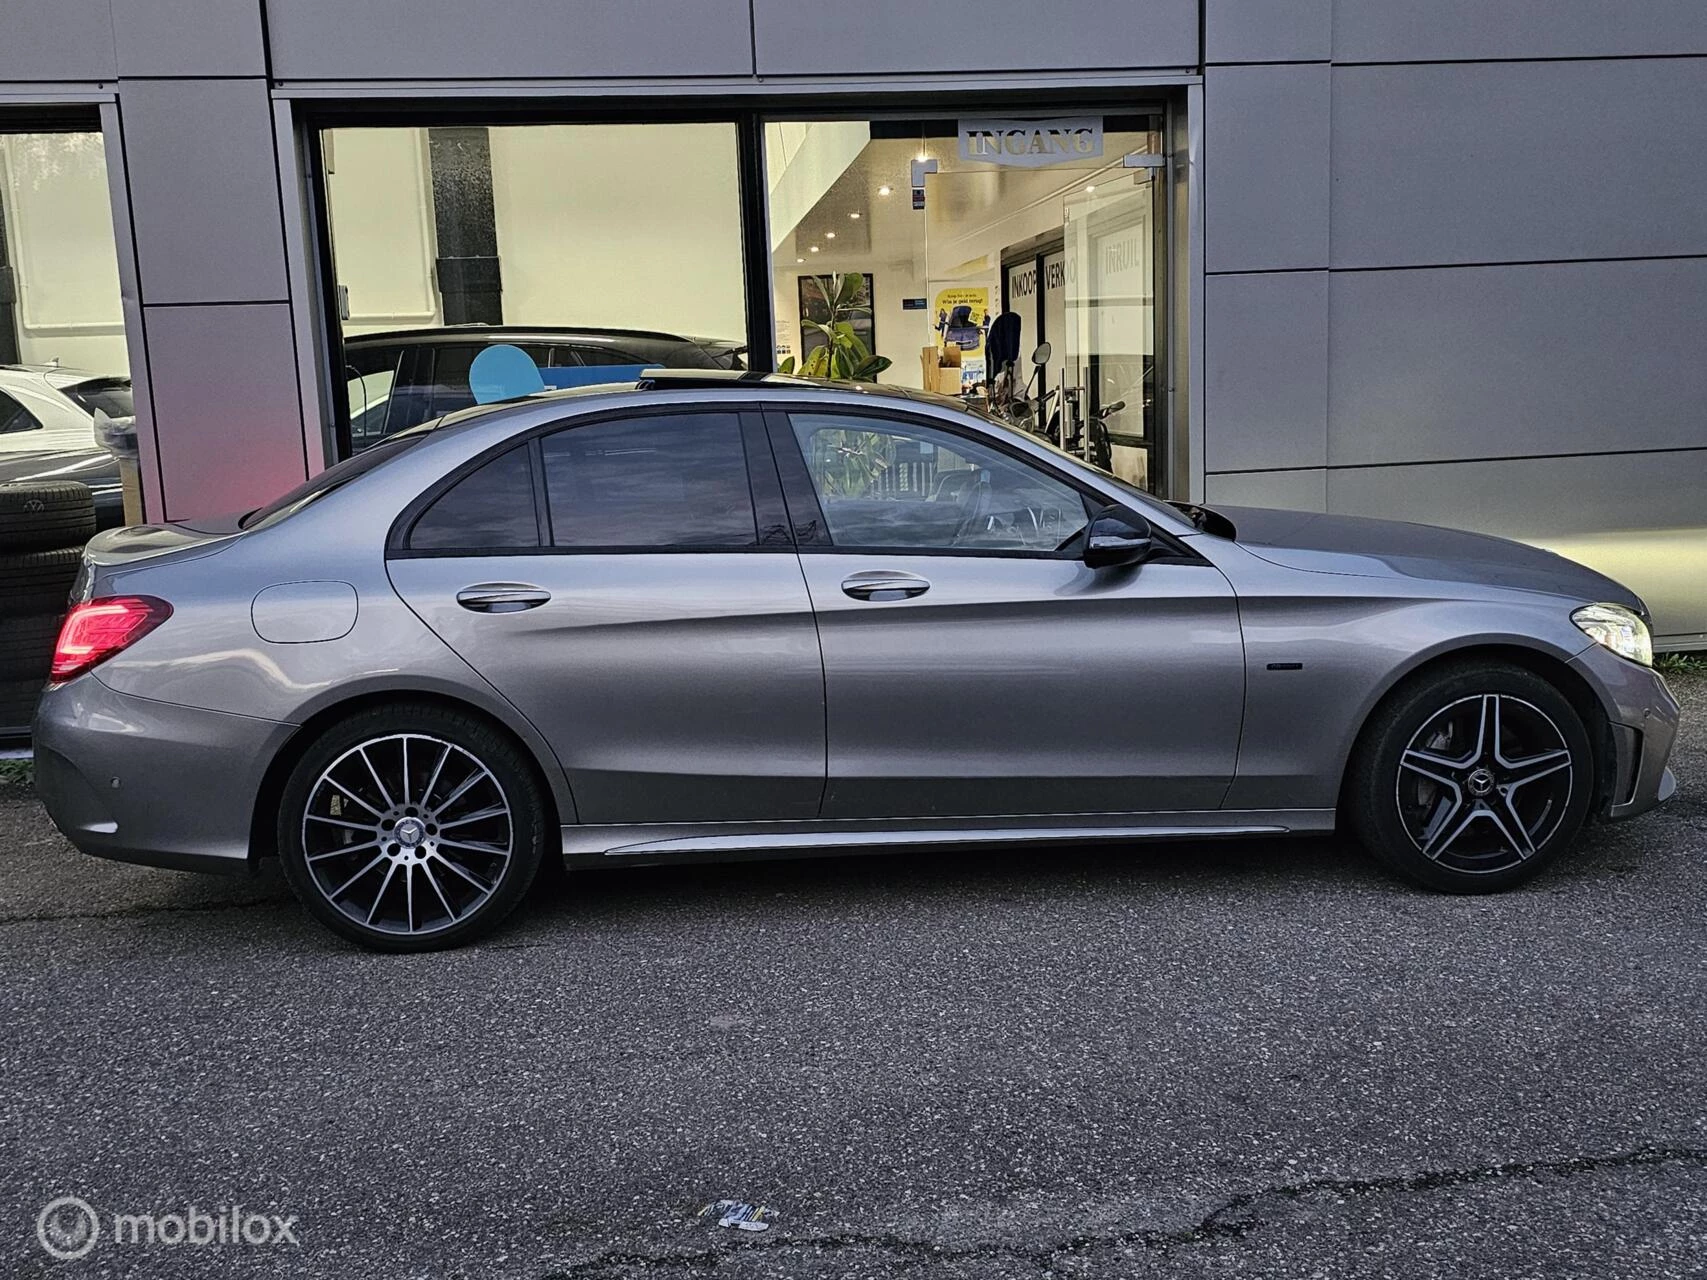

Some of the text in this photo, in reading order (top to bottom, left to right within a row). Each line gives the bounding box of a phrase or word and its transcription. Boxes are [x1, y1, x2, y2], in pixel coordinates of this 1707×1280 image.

[966, 128, 1094, 155] INGANG
[1105, 238, 1140, 274] INRUIL
[1011, 270, 1037, 299] INKOOP
